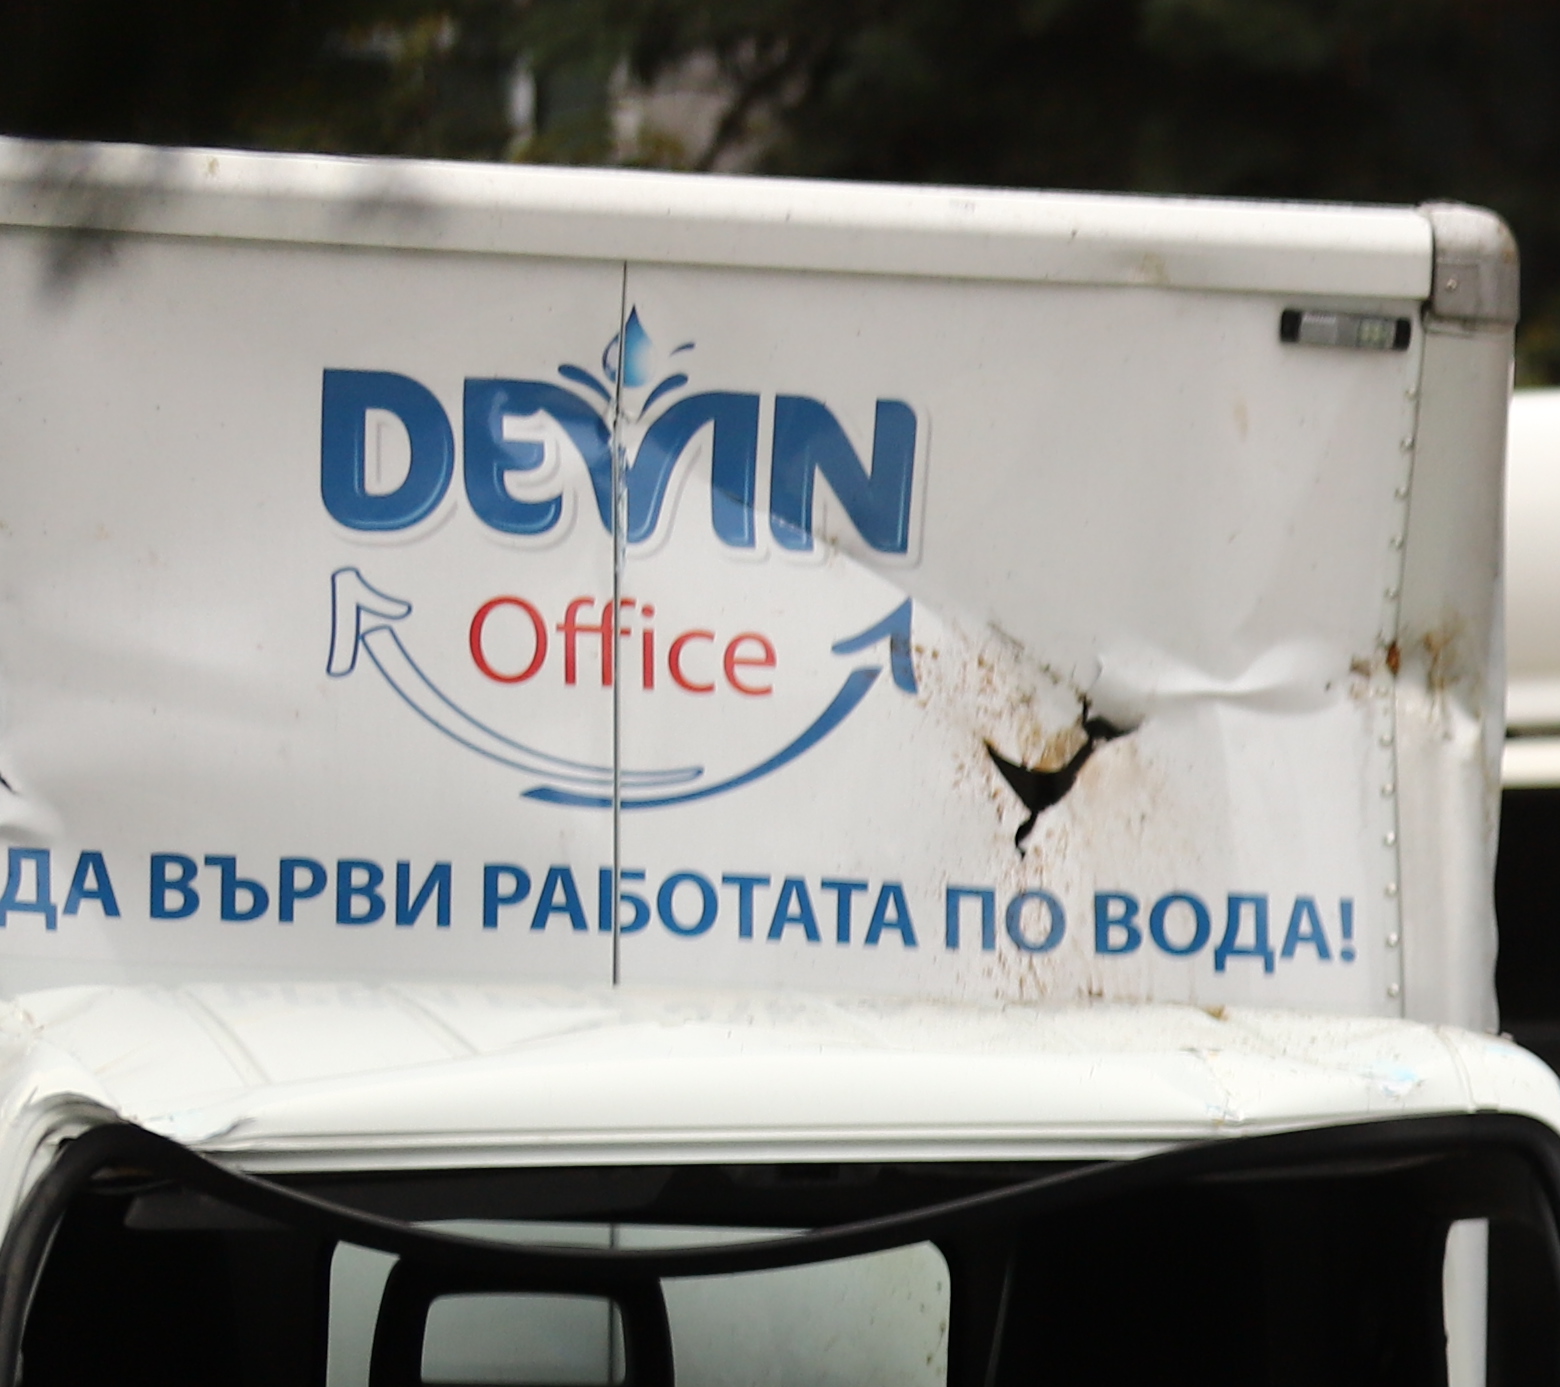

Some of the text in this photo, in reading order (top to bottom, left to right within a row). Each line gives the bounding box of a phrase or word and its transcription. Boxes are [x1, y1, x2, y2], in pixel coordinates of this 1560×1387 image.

[321, 367, 918, 554] DEVIN
[468, 594, 778, 696] Office
[0, 847, 1357, 975] ДА ВЪРВИ РАБОТАТА ПО ВОДА!
